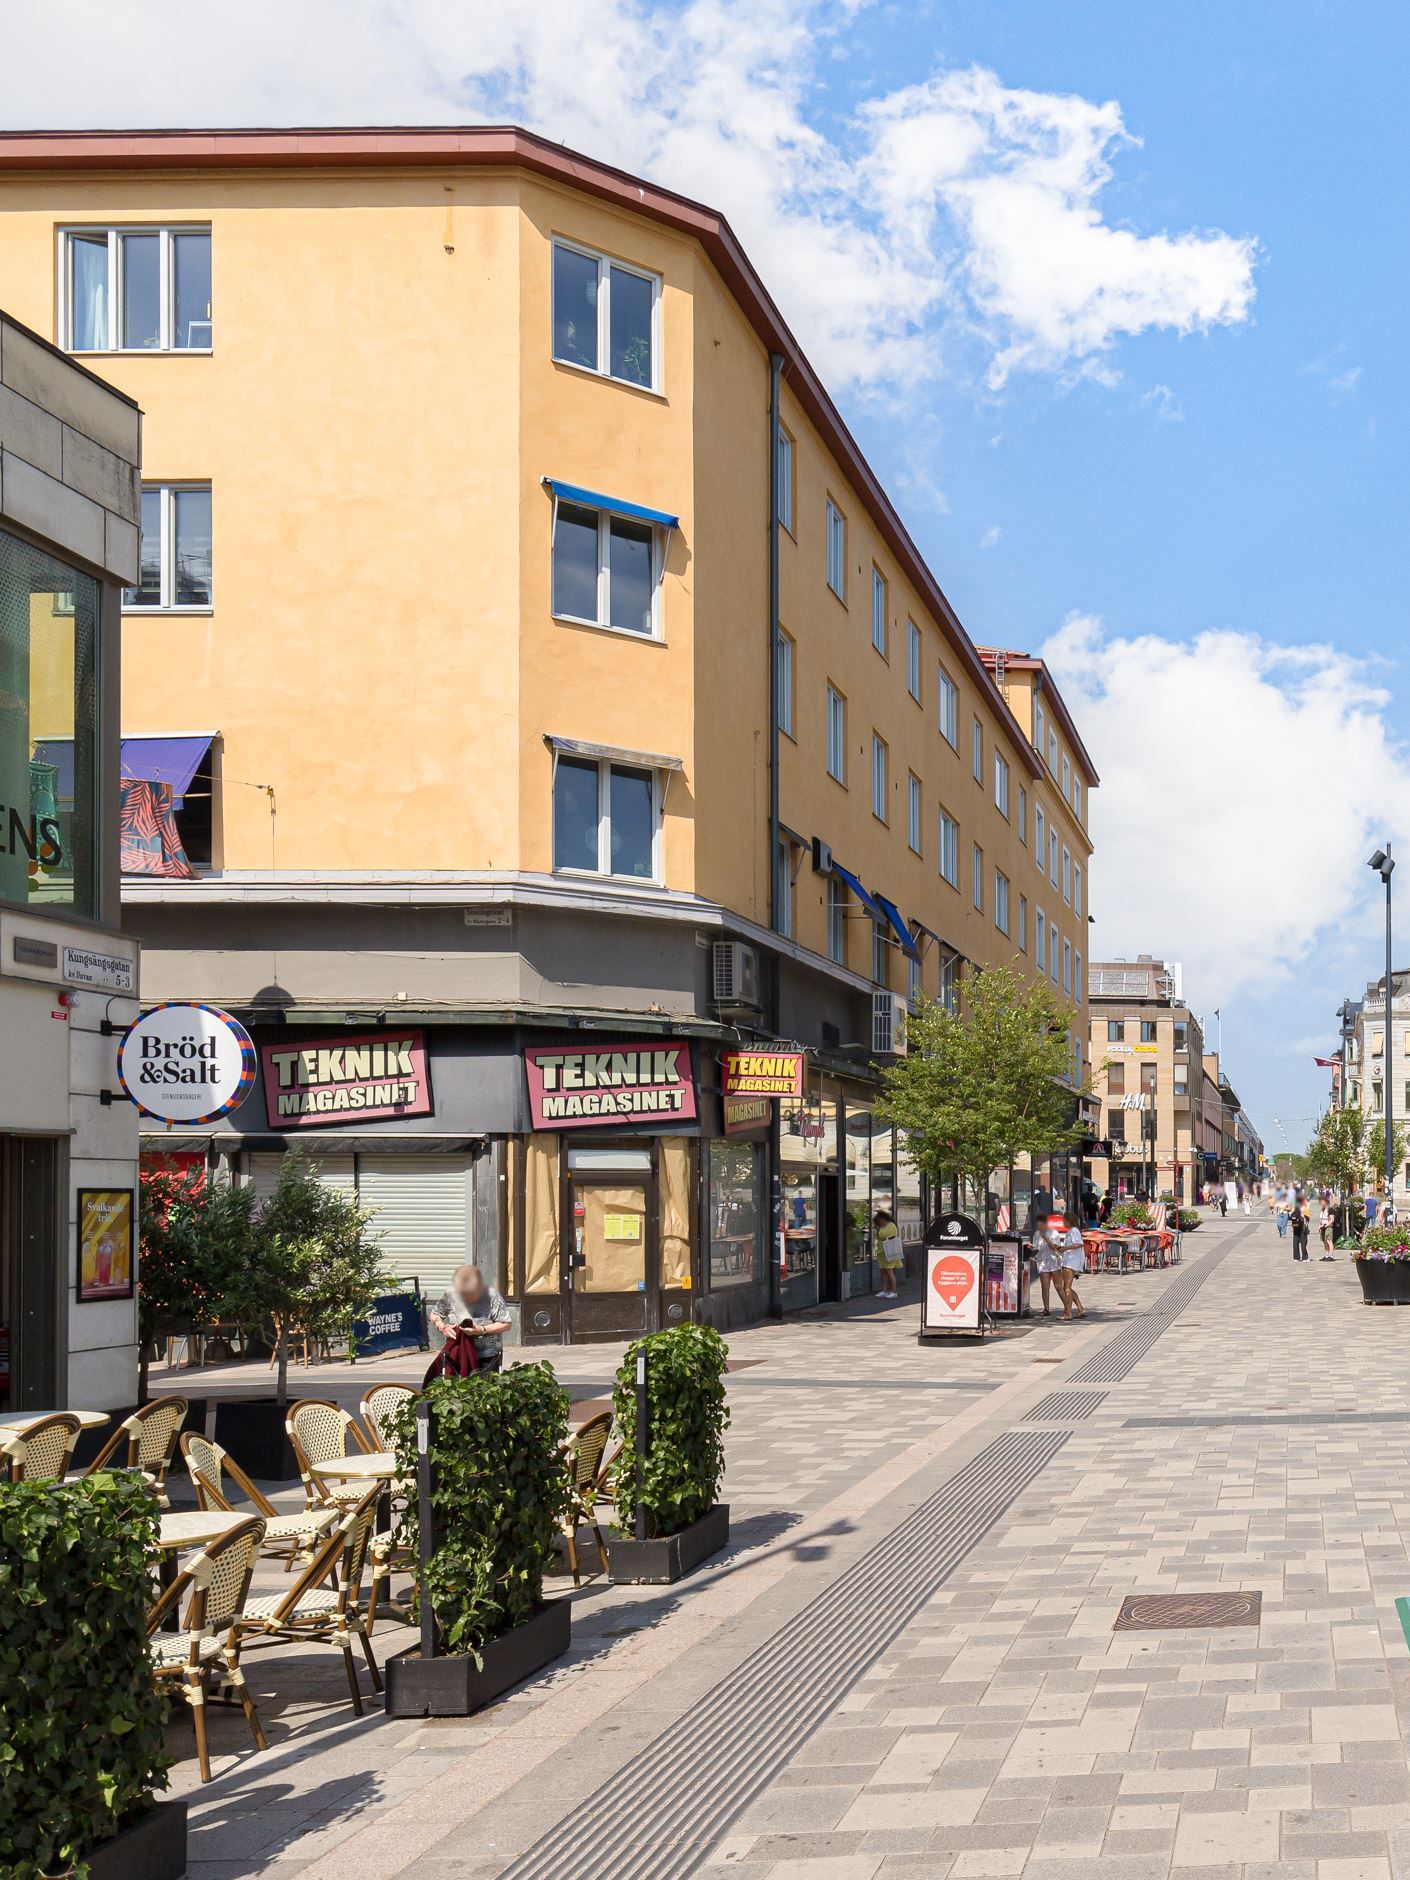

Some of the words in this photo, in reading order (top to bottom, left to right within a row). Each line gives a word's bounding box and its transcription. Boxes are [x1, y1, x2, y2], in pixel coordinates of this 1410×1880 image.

[67, 948, 130, 974] Kungsängsgatan
[115, 974, 130, 988] 5-3
[140, 1035, 218, 1059] Bröd
[140, 1060, 221, 1084] &Salt
[271, 1040, 415, 1087] TEKNIK
[535, 1050, 681, 1090] TEKNIK
[727, 1056, 798, 1077] TEKNIK
[727, 1079, 798, 1092] MAGASINET
[278, 1081, 419, 1116] MAGASINET
[542, 1089, 686, 1118] MAGASINET
[728, 1100, 767, 1124] MAGASINET
[368, 1312, 403, 1326] WAYNE'S
[369, 1322, 401, 1335] COFFEE
